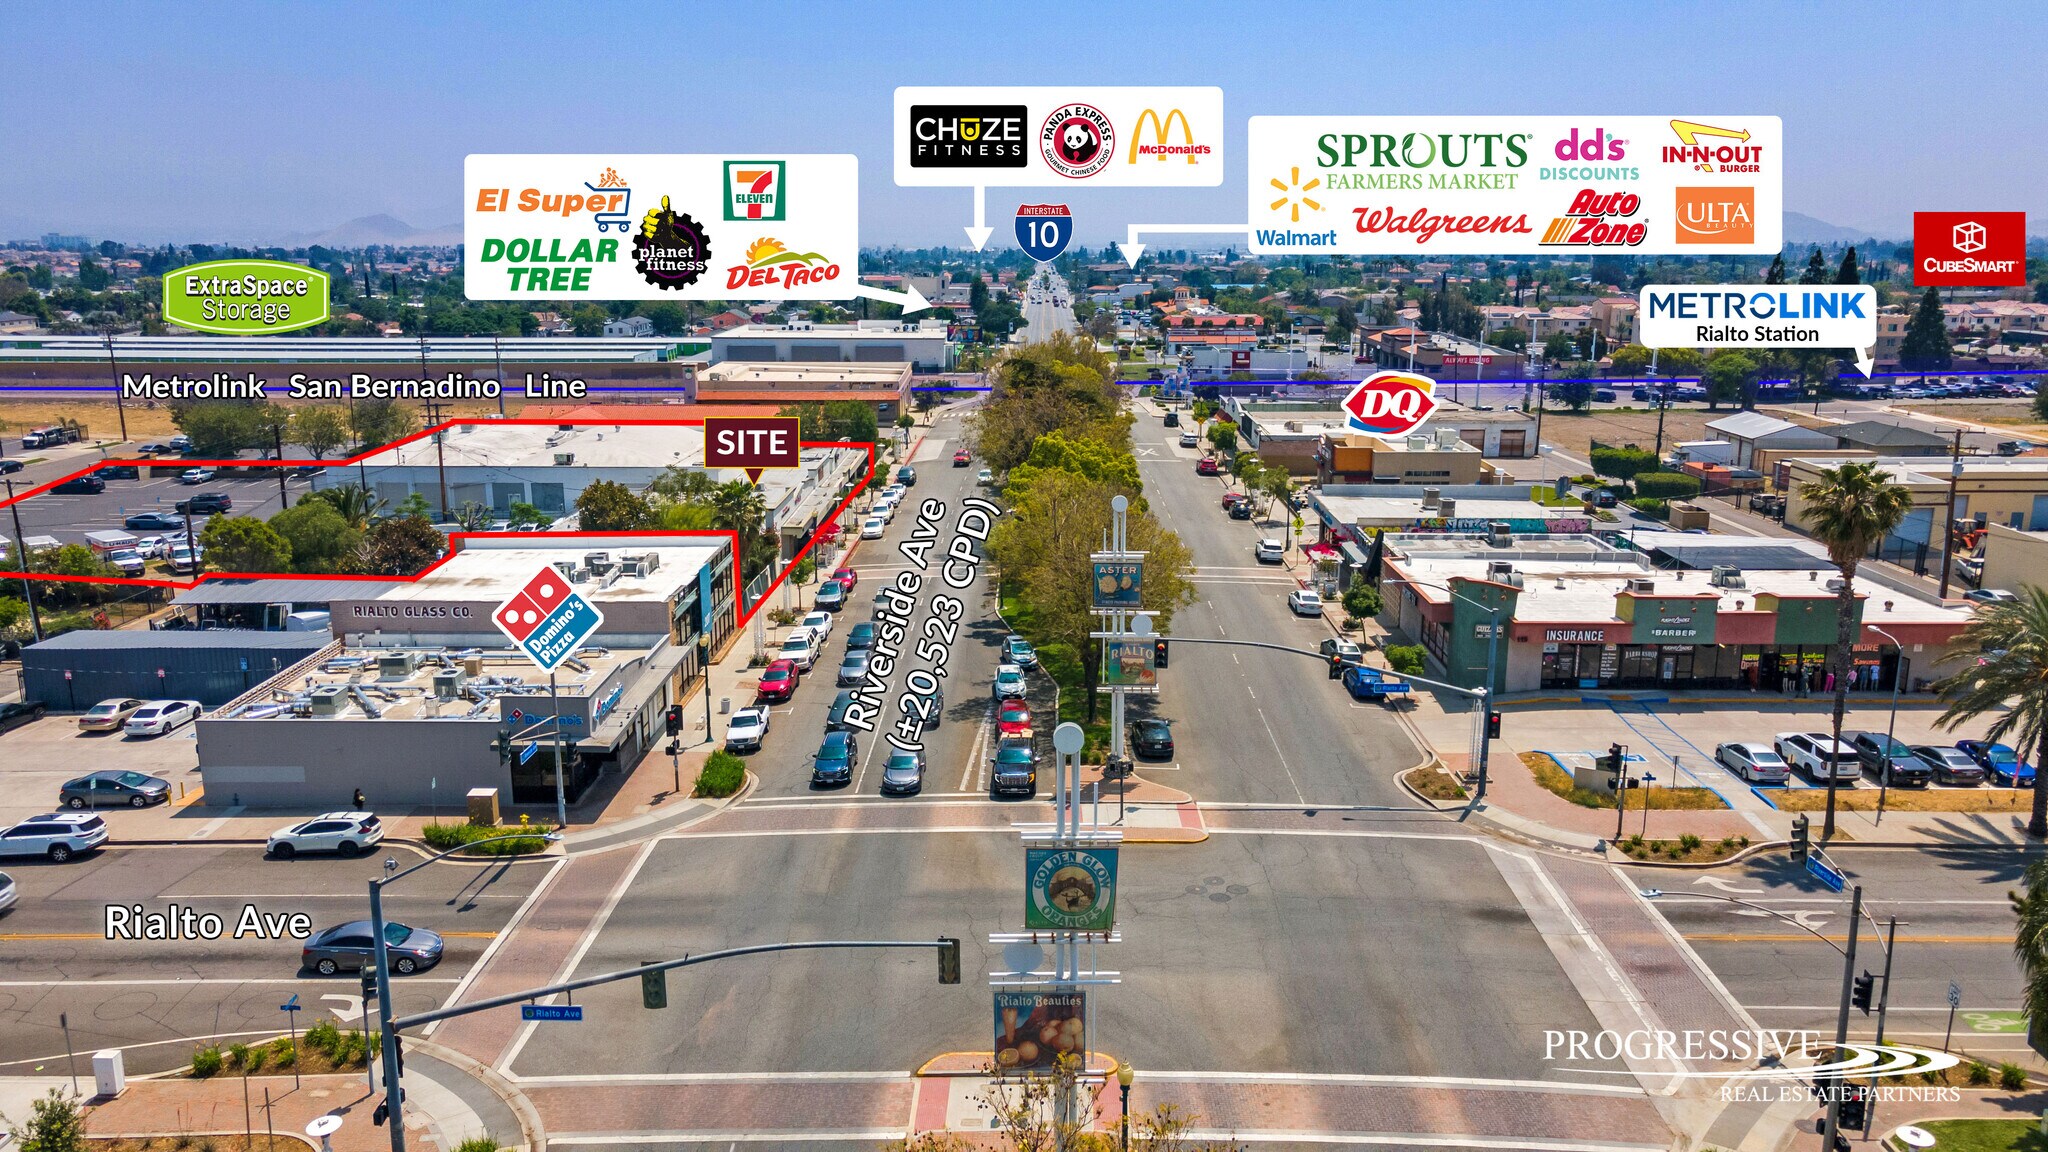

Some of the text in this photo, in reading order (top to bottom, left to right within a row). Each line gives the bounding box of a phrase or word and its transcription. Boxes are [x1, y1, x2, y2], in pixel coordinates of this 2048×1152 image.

[1099, 566, 1137, 574] ASTER
[352, 605, 474, 619] RIALTO GLASS CO.
[1546, 630, 1604, 641] INSURANCE
[1111, 645, 1154, 660] RIALTO
[523, 713, 583, 726] Domno's
[1033, 851, 1111, 889] GOLDEN GLOW
[1041, 905, 1103, 927] ORANGES
[998, 995, 1082, 1007] Rialto Beauties
[536, 1009, 580, 1018] Rialto Ave
